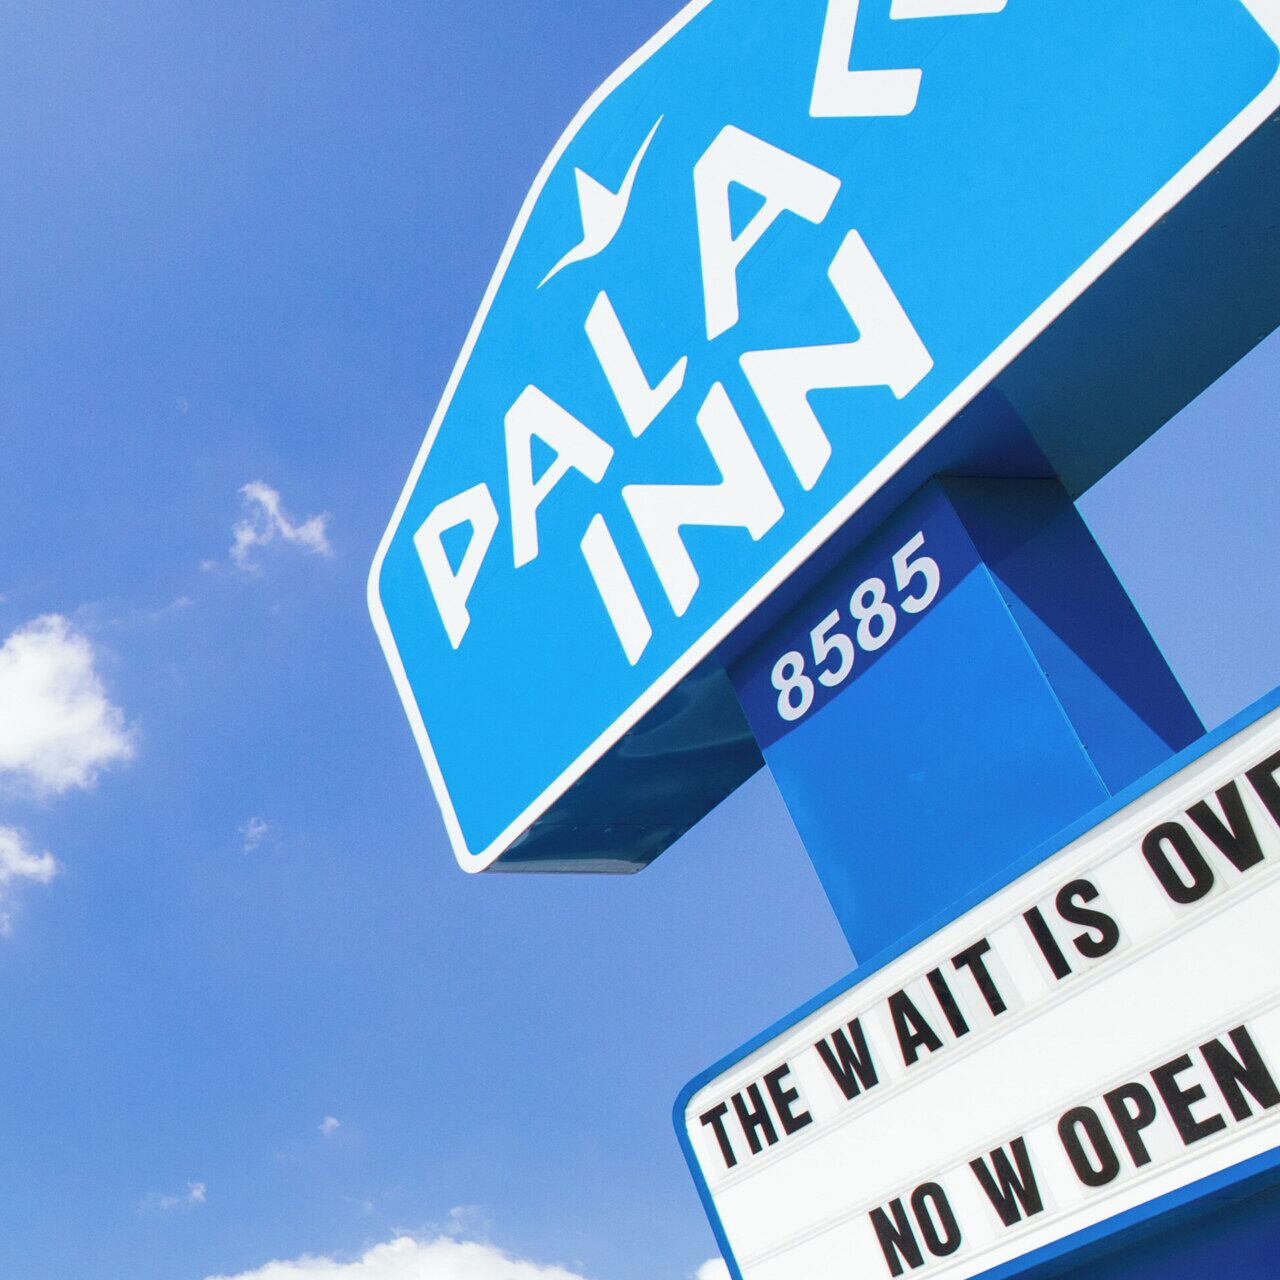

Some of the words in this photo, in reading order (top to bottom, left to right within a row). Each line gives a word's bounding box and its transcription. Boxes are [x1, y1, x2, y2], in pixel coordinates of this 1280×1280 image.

[413, 0, 1008, 650] PALAC
[580, 228, 934, 666] INN
[770, 531, 942, 721] 8585
[699, 1062, 813, 1169] THE
[814, 937, 1008, 1101] WAIT
[1022, 878, 1121, 981] IS
[868, 1135, 1045, 1278] NOW
[1057, 1024, 1280, 1188] OPEN
